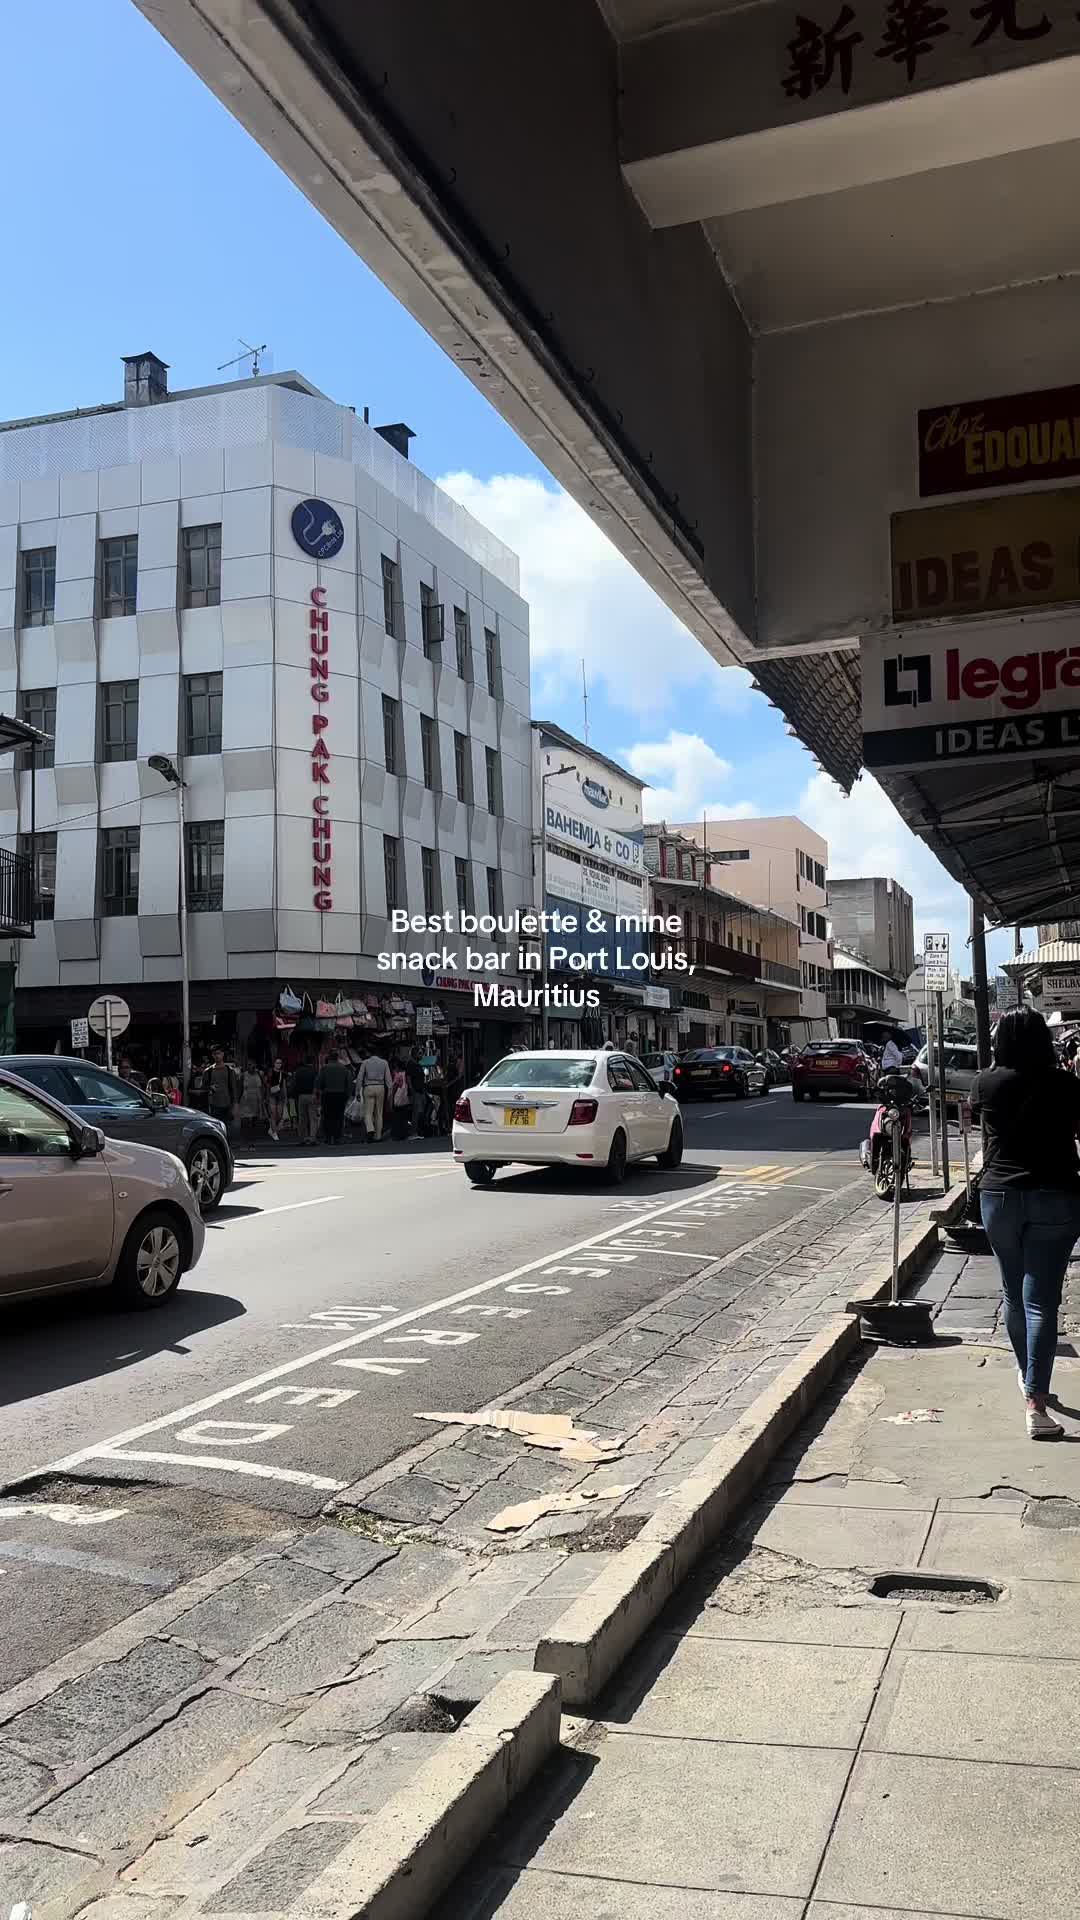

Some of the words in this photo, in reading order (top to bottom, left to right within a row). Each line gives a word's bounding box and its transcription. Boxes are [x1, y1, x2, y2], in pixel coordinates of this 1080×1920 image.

[781, 0, 1080, 100] 新華光
[925, 407, 985, 452] Chez
[964, 416, 1080, 475] EDOUA
[897, 541, 1055, 609] IDEAS
[310, 586, 330, 703] CHUNG
[311, 714, 331, 784] PAK
[935, 719, 1046, 756] IDEAS
[1060, 715, 1080, 742] L
[312, 795, 333, 911] CHUNG
[546, 807, 602, 849] BAHEMIA
[604, 835, 612, 853] &
[615, 841, 630, 860] CO
[174, 1252, 639, 1446] RESERVED
[280, 1304, 400, 1331] 101
